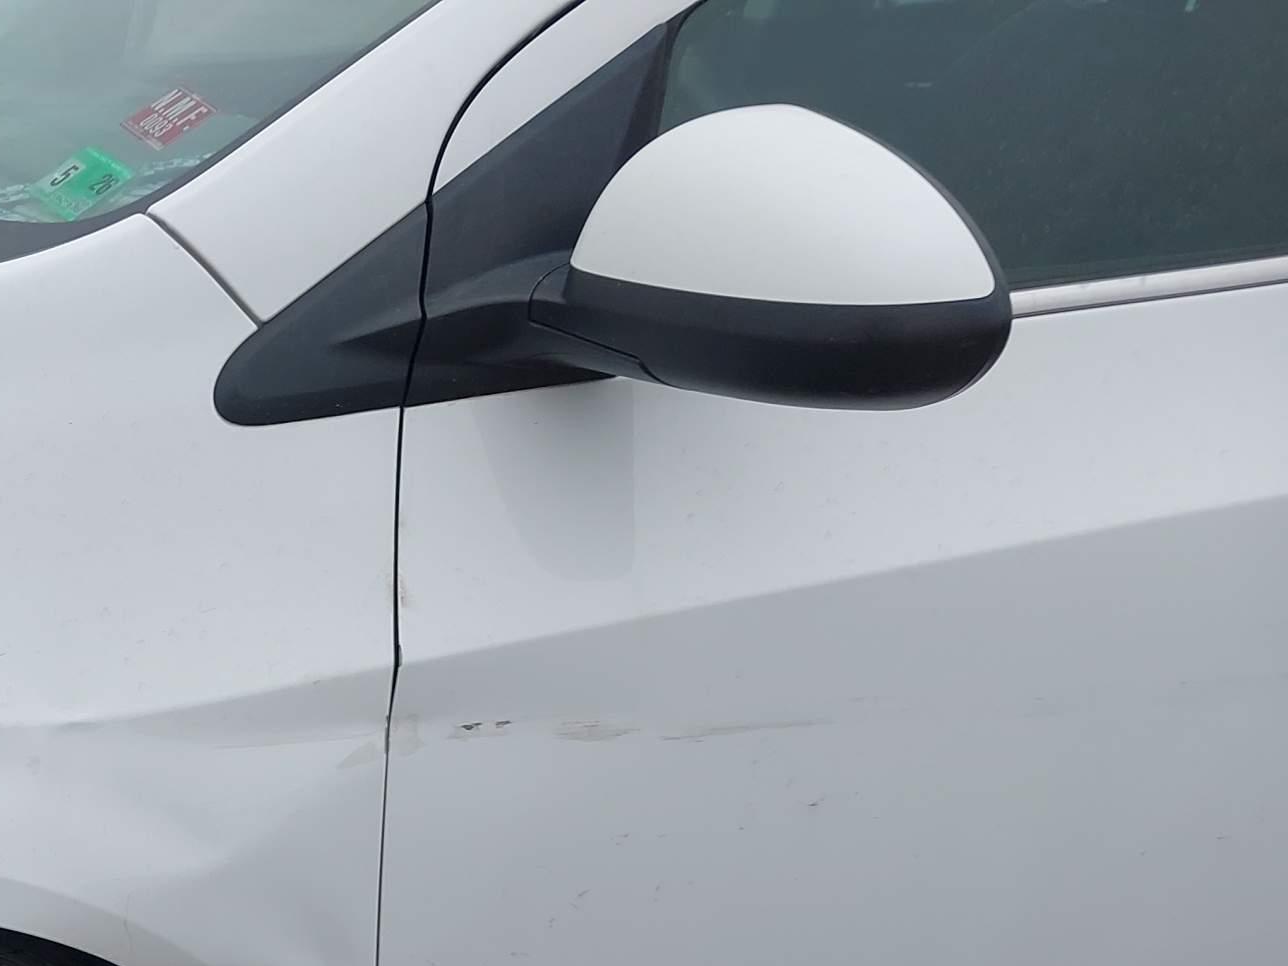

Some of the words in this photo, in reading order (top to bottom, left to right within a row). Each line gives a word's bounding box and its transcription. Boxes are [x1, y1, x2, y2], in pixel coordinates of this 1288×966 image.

[139, 113, 173, 137] 0093
[49, 164, 80, 187] 5
[88, 174, 120, 195] 26
